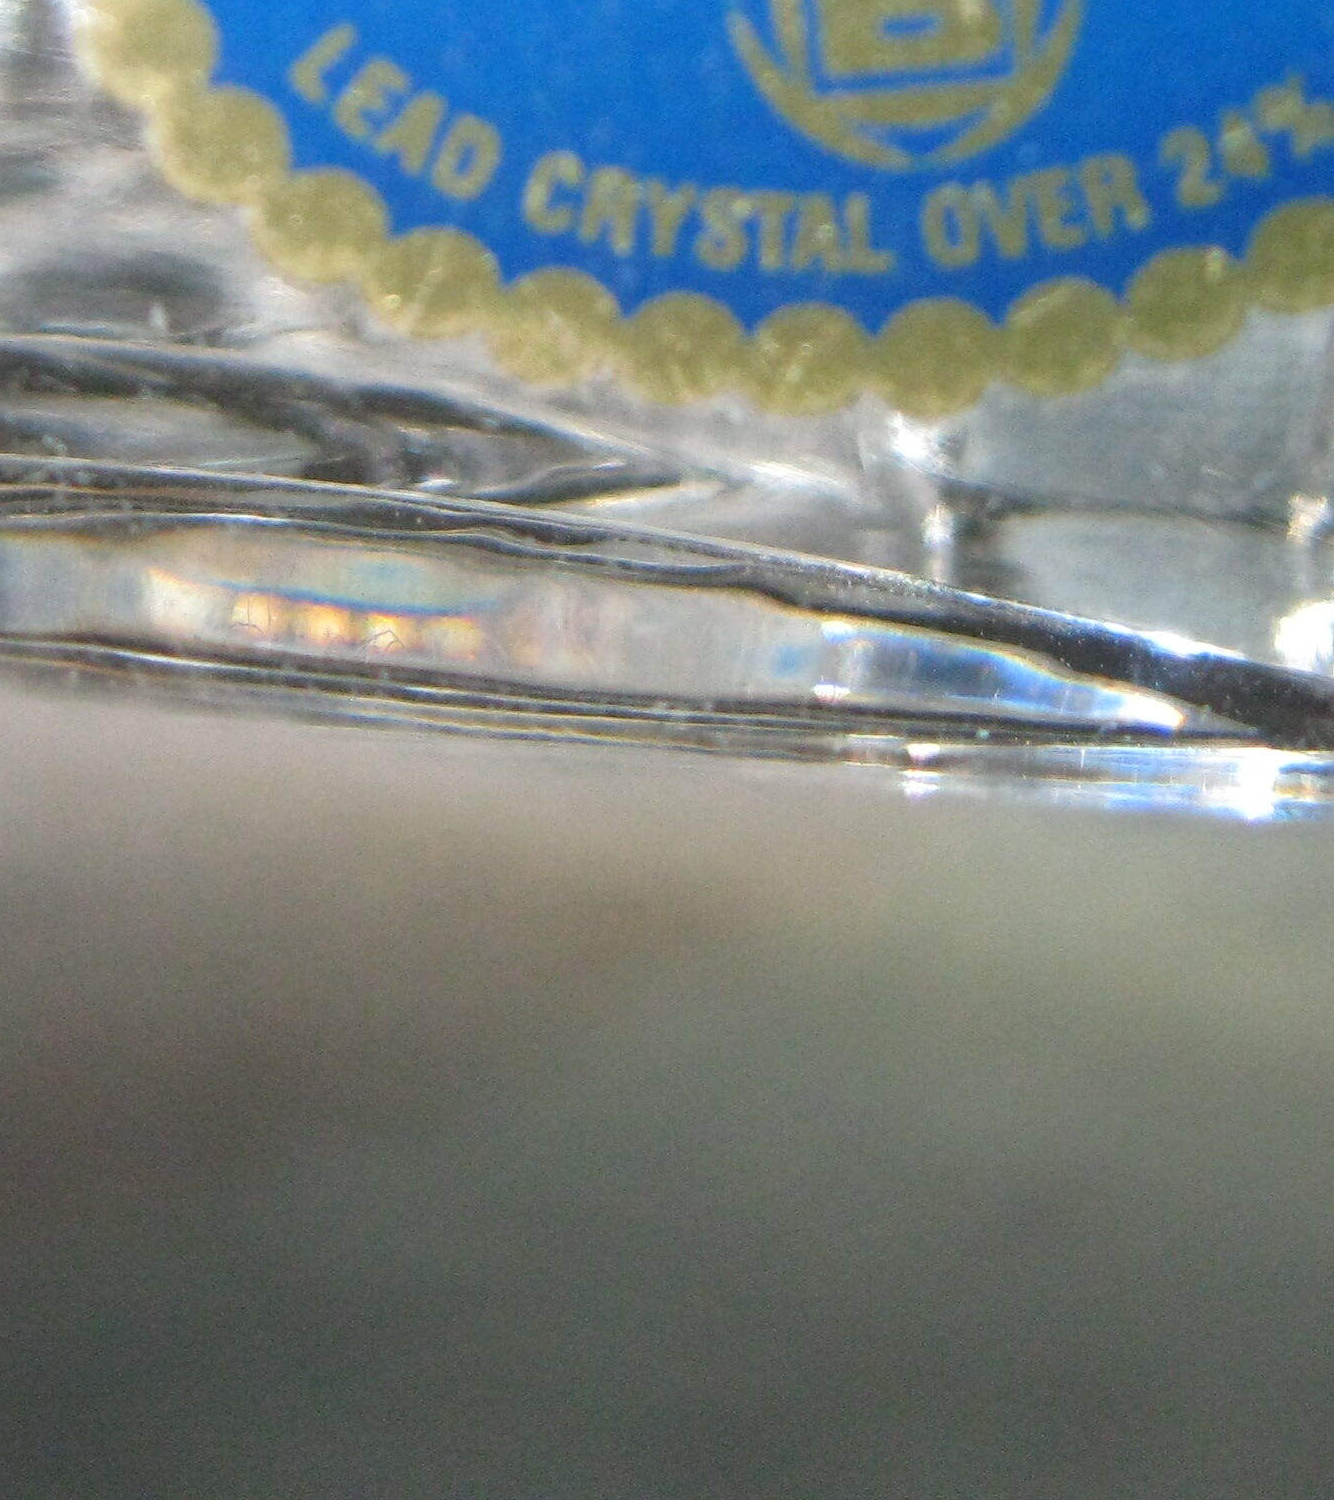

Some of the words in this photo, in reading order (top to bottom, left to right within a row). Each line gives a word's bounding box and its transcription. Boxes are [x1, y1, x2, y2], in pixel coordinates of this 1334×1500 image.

[287, 20, 505, 204] LEAD
[522, 147, 898, 275] CRYSTAL
[919, 152, 1153, 271] OVER
